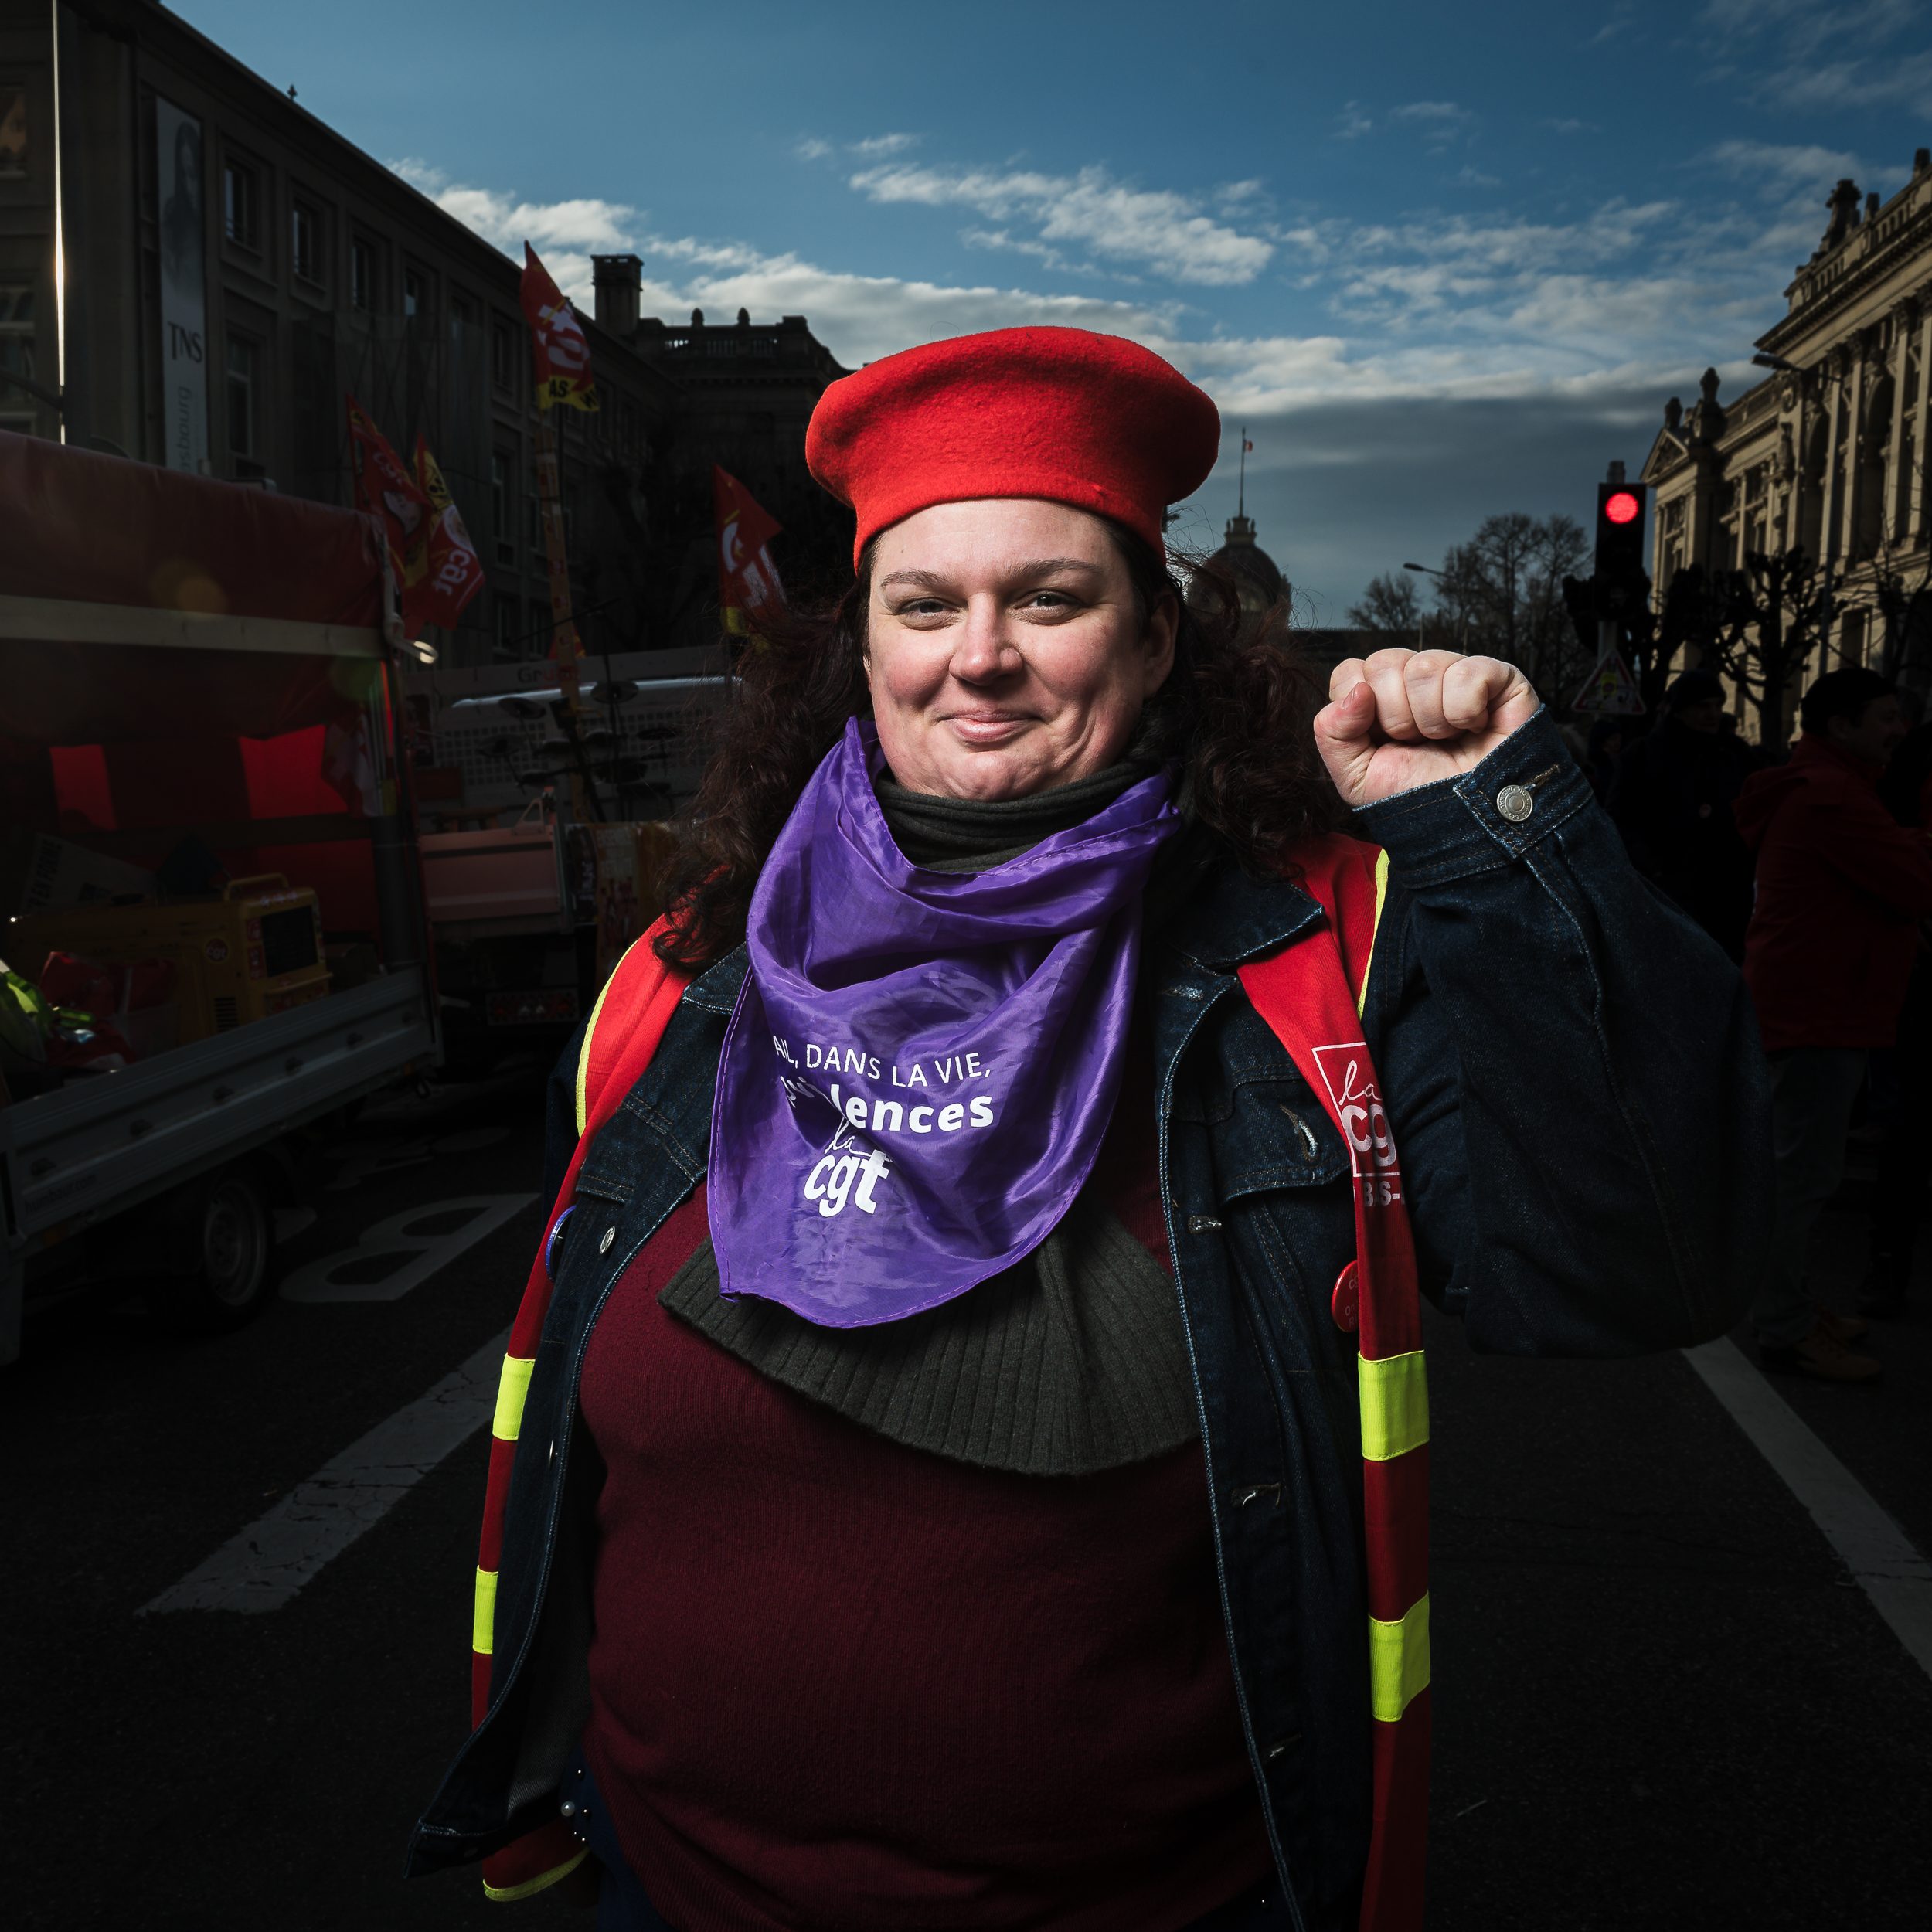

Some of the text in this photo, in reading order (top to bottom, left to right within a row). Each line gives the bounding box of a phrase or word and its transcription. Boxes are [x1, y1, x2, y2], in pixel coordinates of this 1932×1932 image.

[168, 321, 203, 364] TNS
[206, 945, 226, 960] cgt
[806, 1044, 881, 1080] DANS
[893, 1064, 928, 1088] LA
[934, 1052, 991, 1084] VIE,
[1338, 1060, 1383, 1106] la
[25, 1174, 97, 1214] humbaur.com
[804, 1149, 889, 1218] cgt
[1363, 1180, 1405, 1207] BAS-
